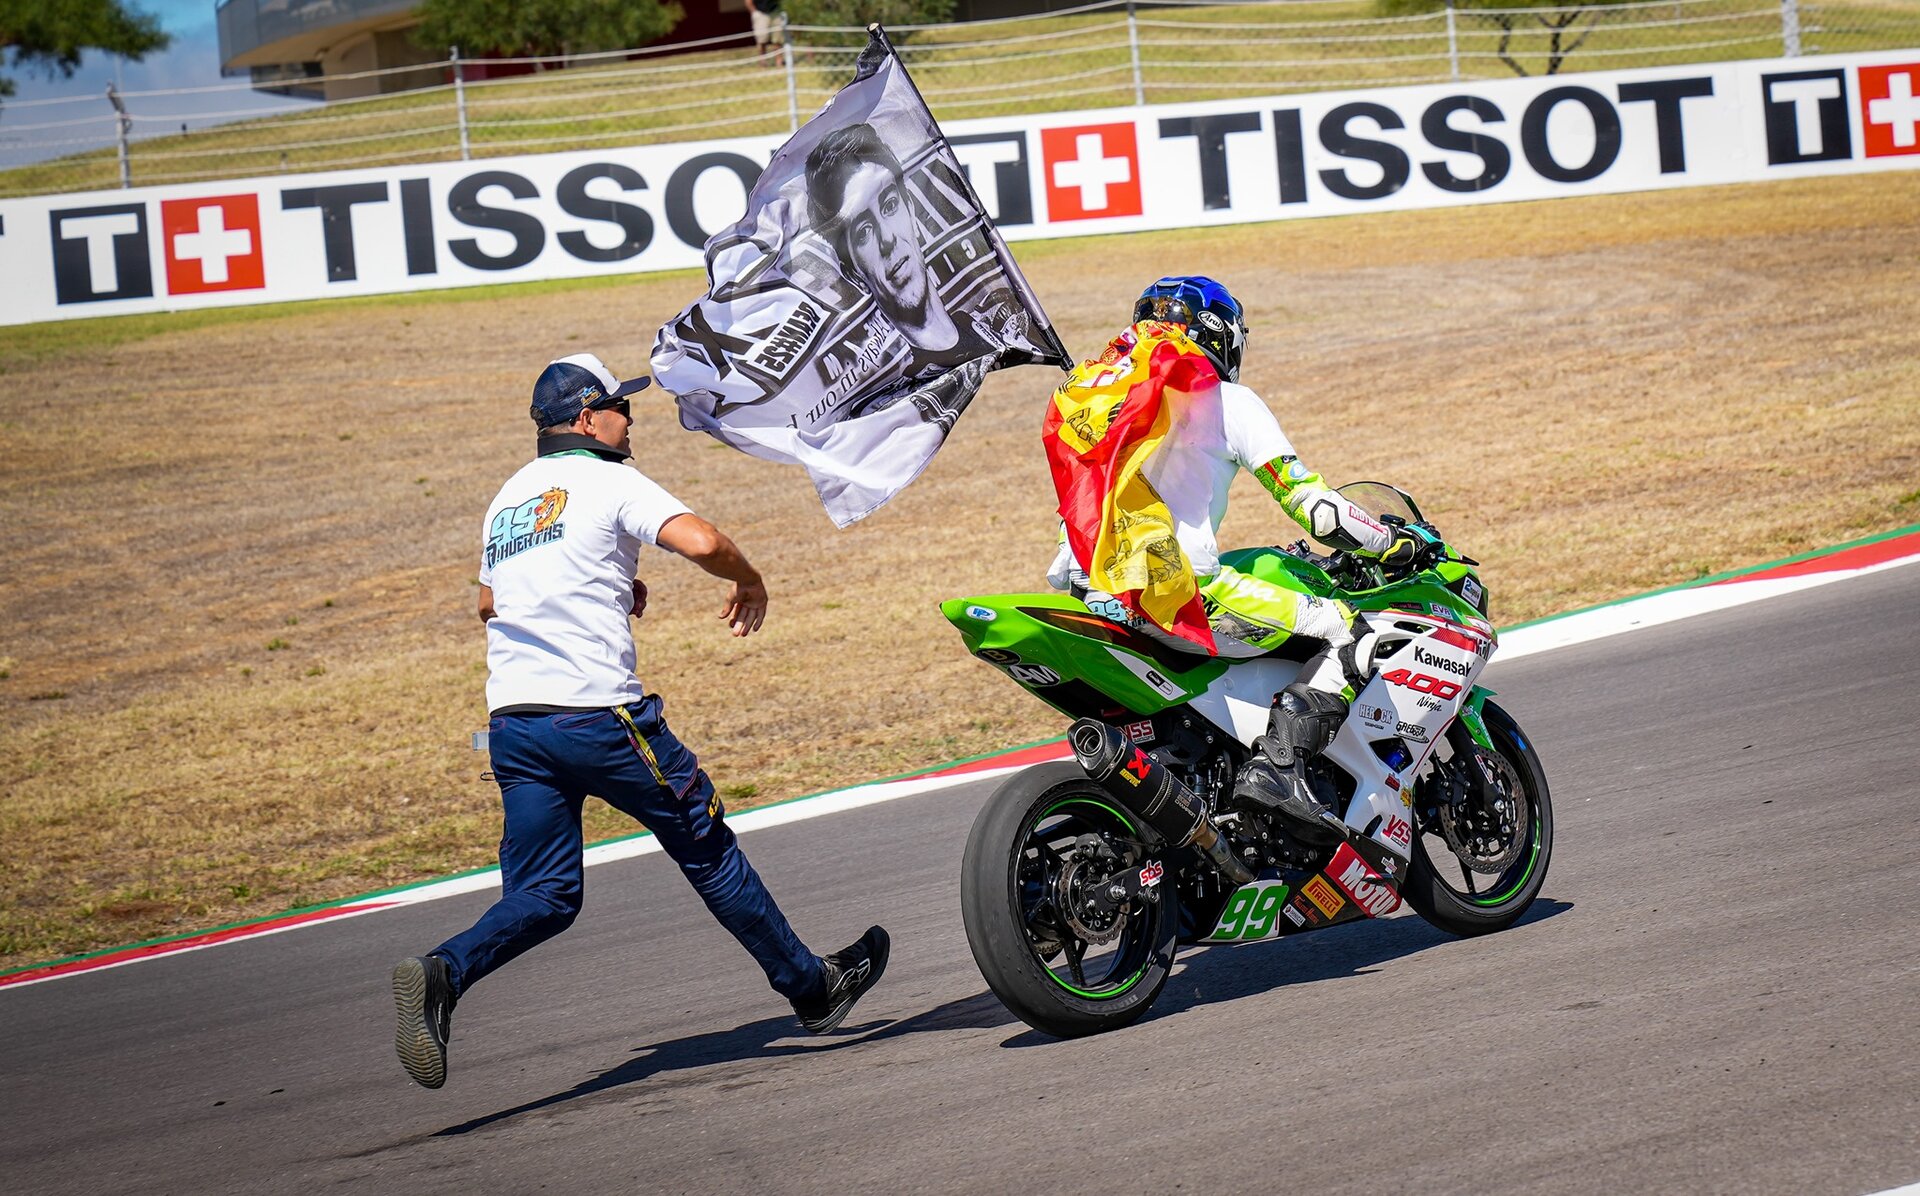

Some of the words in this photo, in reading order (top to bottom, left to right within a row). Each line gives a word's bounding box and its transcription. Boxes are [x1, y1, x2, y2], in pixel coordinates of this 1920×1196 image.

[1158, 76, 1713, 211] TISSOT
[280, 150, 776, 283] TISSO
[1200, 313, 1222, 330] Arai
[1414, 645, 1474, 678] Kawasak
[1381, 668, 1462, 701] 400
[1416, 696, 1442, 712] Ninja
[1210, 884, 1290, 940] 99
[1307, 880, 1341, 915] PIRELLI
